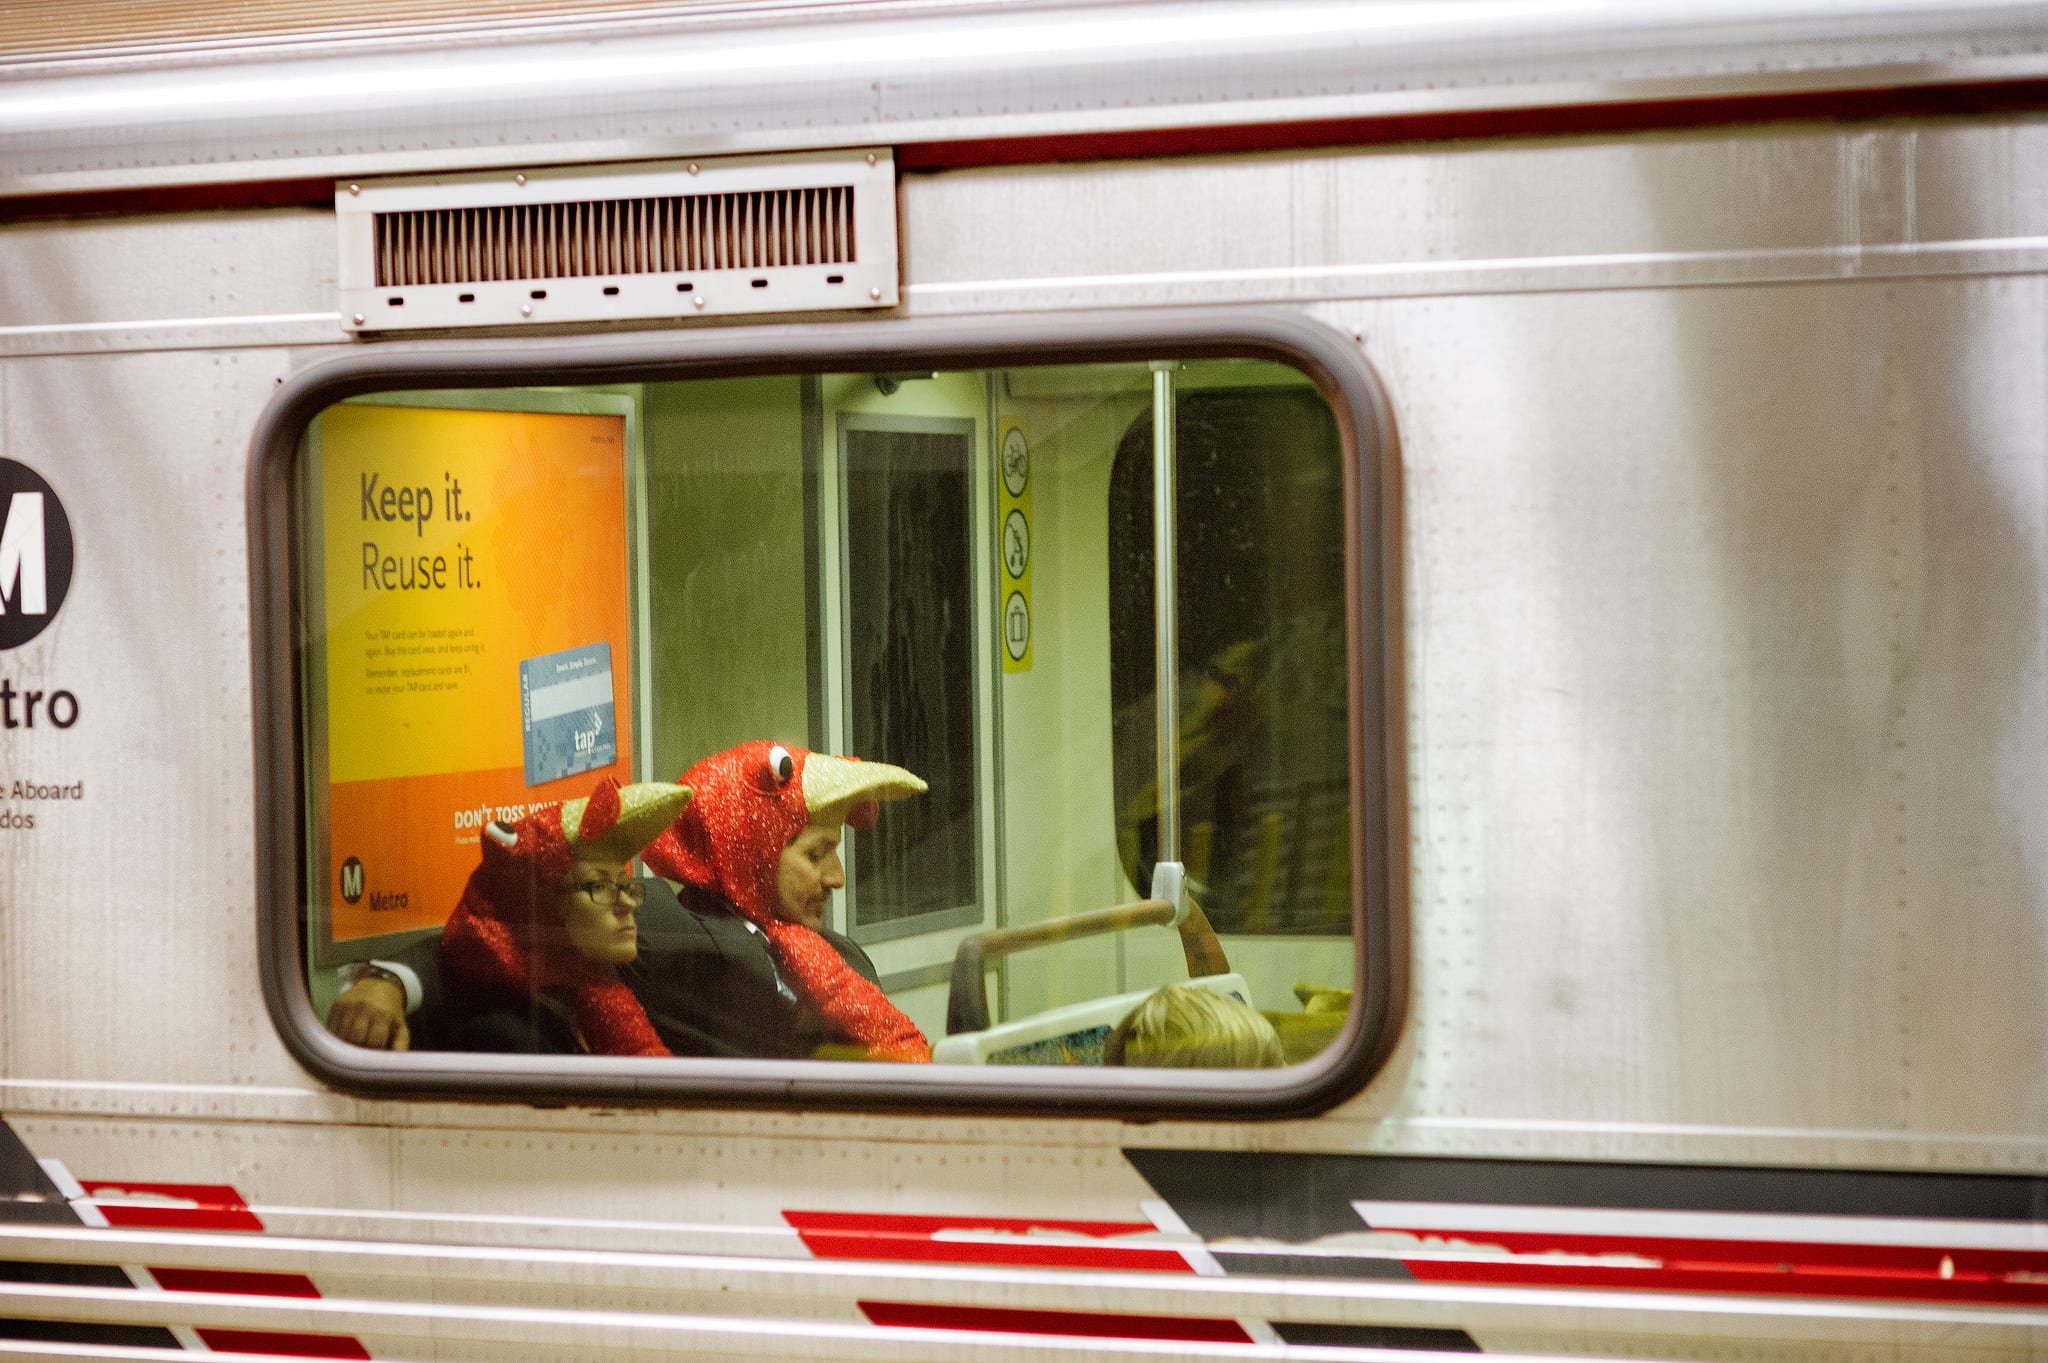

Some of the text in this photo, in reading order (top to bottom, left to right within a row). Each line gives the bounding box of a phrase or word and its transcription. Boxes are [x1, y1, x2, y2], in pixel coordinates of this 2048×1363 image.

[361, 471, 471, 538] Keep it.
[362, 541, 481, 590] Reuse it.
[574, 730, 595, 755] tap
[11, 779, 83, 800] Aboard
[0, 809, 34, 829] dos
[454, 802, 492, 829] DON'T
[496, 804, 525, 824] TOSS
[344, 863, 362, 898] M
[369, 890, 408, 912] Metro
